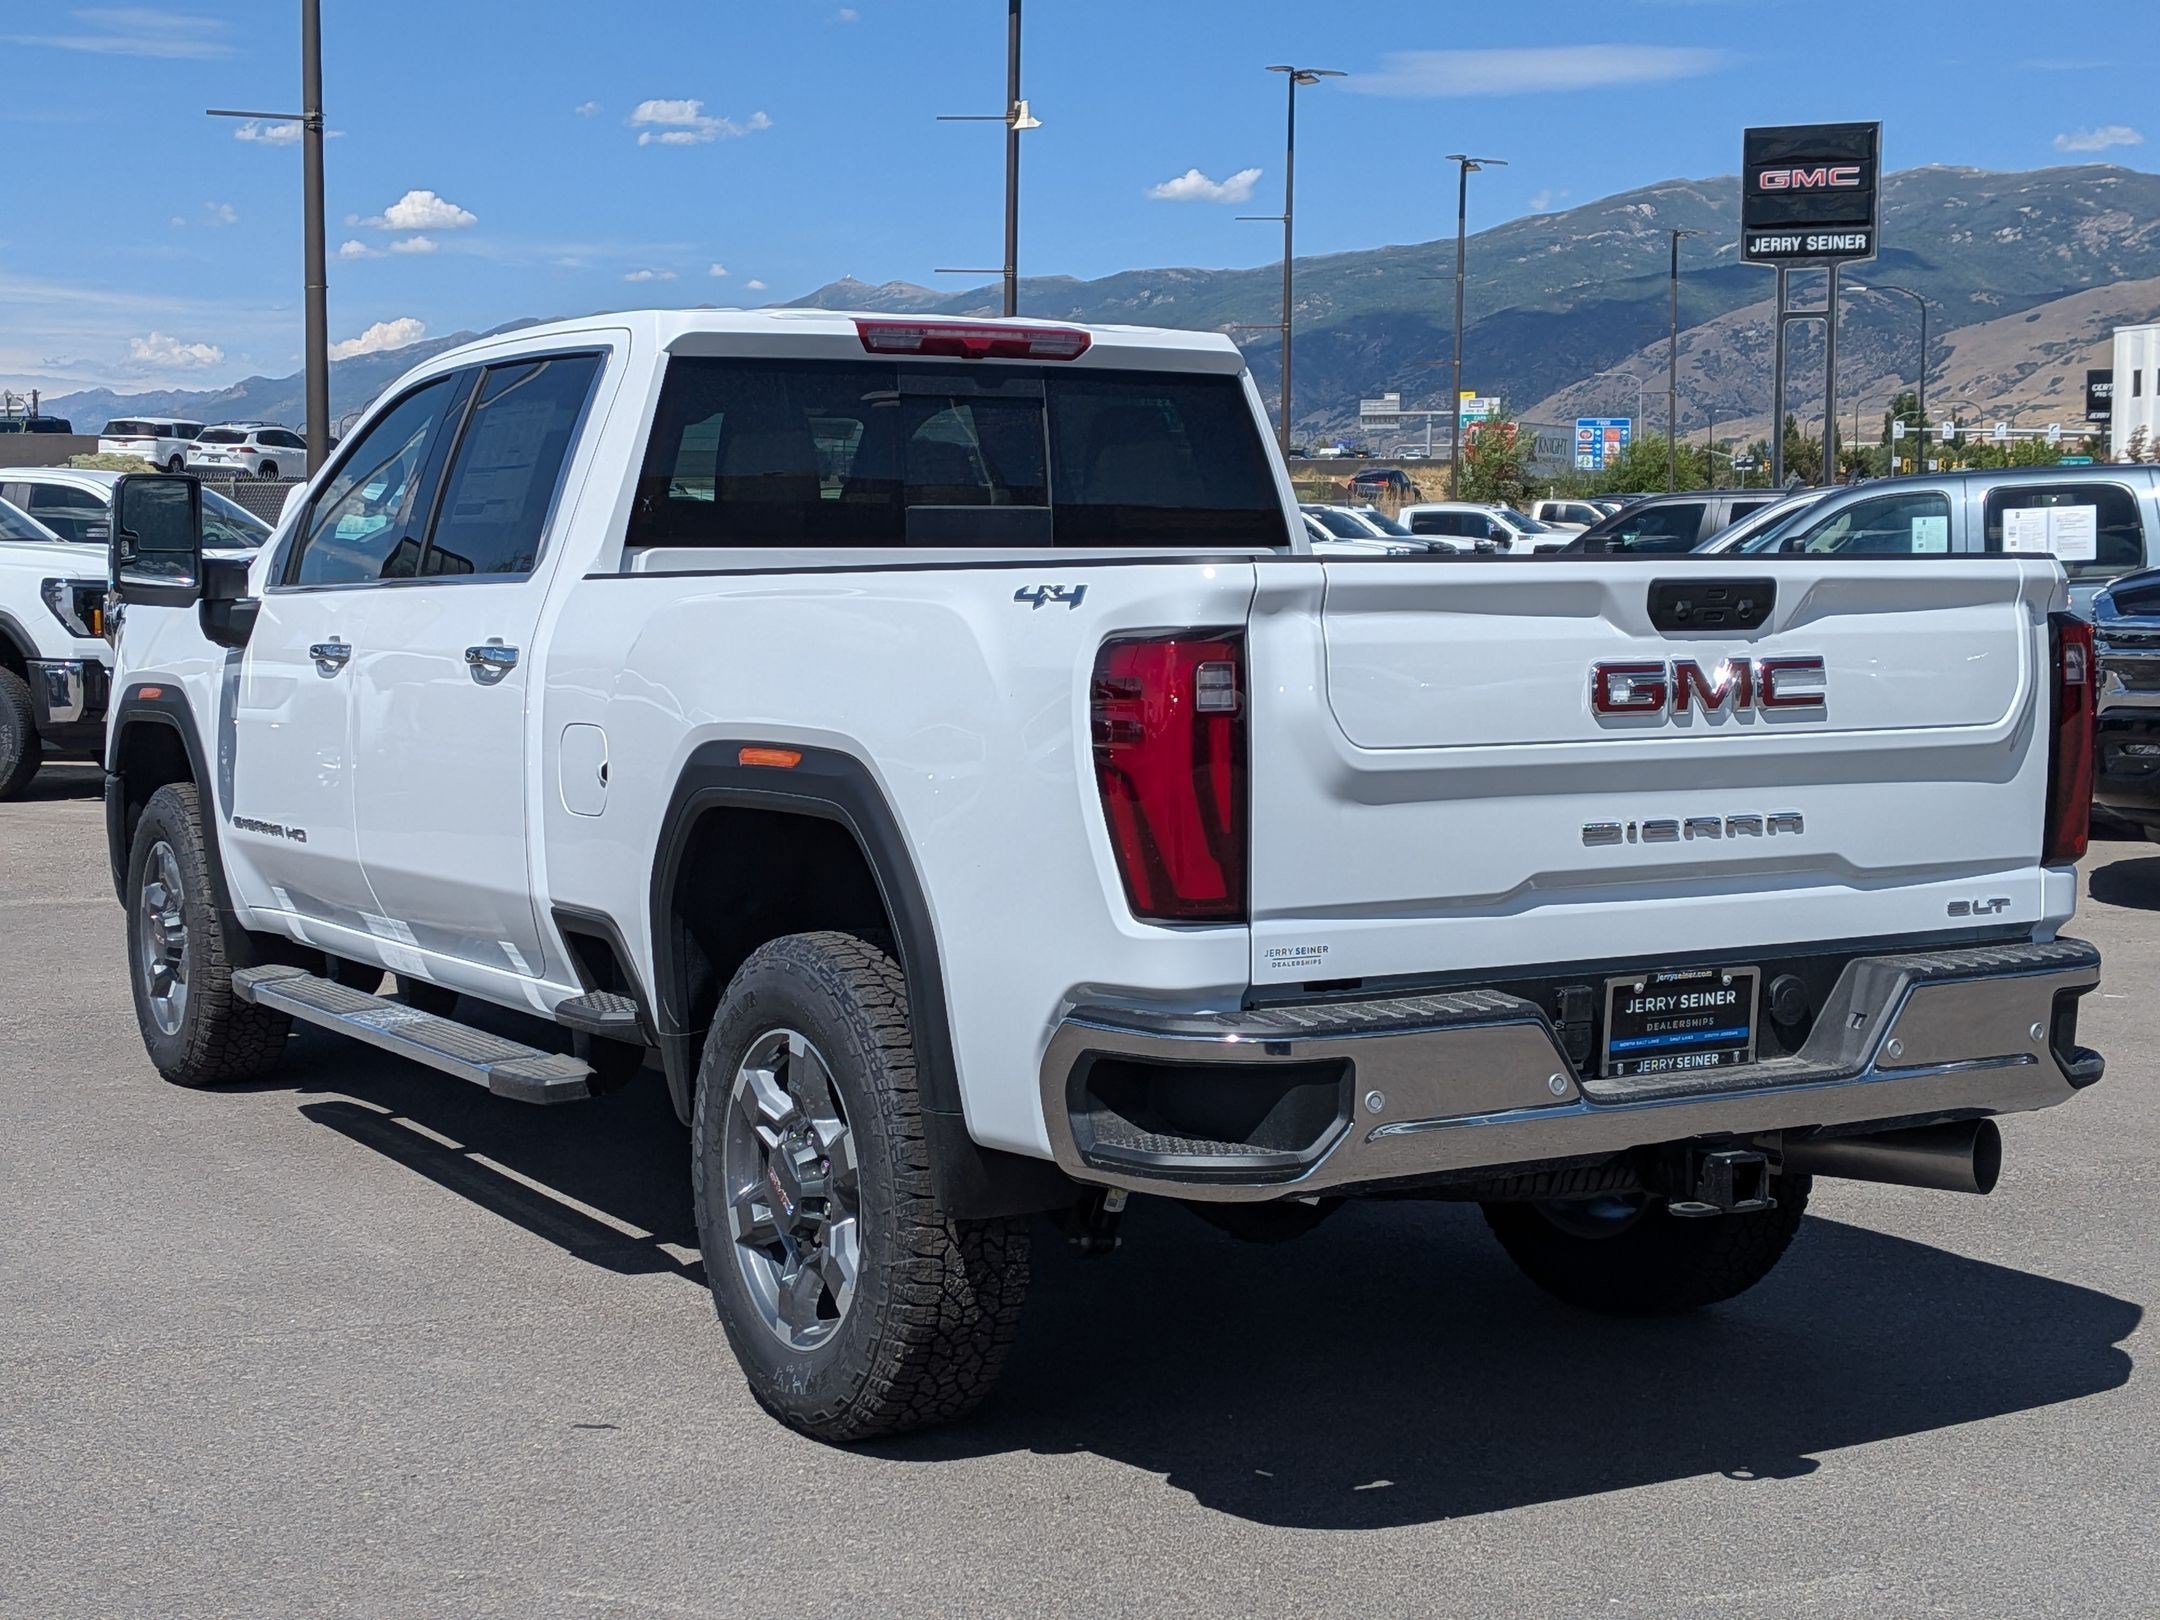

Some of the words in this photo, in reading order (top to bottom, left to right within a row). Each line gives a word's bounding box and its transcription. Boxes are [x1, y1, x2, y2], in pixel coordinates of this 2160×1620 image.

[1760, 166, 1860, 189] GMC
[1750, 236, 1801, 253] JERRY
[1806, 234, 1866, 251] SEINER
[1590, 655, 1827, 716] GMC
[233, 816, 284, 838] SIERRA
[285, 826, 307, 843] HD
[1582, 811, 1804, 847] SIERRA
[1946, 897, 2011, 917] SLT
[1264, 947, 1294, 958] JERRY
[1295, 945, 1329, 955] SEINER
[1271, 959, 1322, 968] DEALERSHIPS
[1625, 997, 1680, 1014] JERRY
[1680, 990, 1736, 1008] SEINER
[1646, 1017, 1715, 1032] DEALERSHIPS
[1636, 1056, 1675, 1073] JERRY
[1676, 1054, 1719, 1069] SEINER
